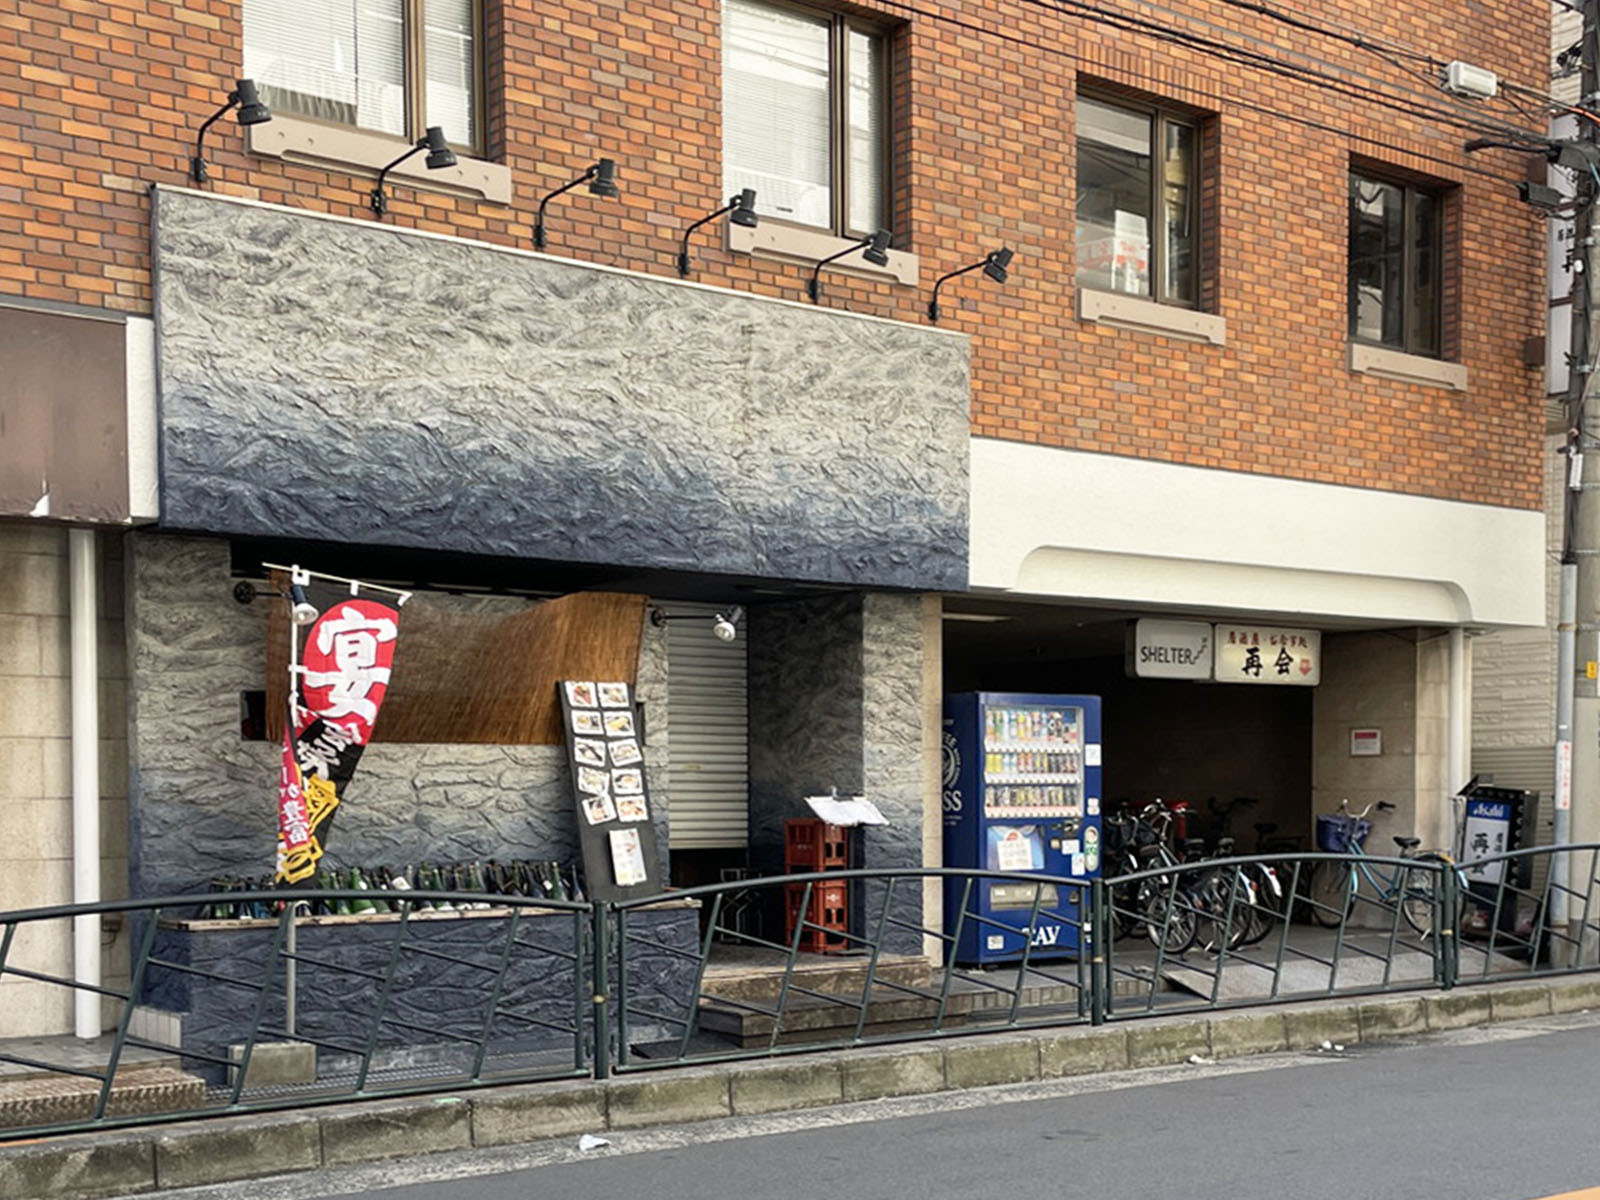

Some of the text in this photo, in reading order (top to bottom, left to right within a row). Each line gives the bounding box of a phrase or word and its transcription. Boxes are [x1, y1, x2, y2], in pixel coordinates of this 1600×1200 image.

[304, 606, 398, 725] 宴
[1140, 646, 1195, 665] SHELTER
[1241, 647, 1294, 677] 再会
